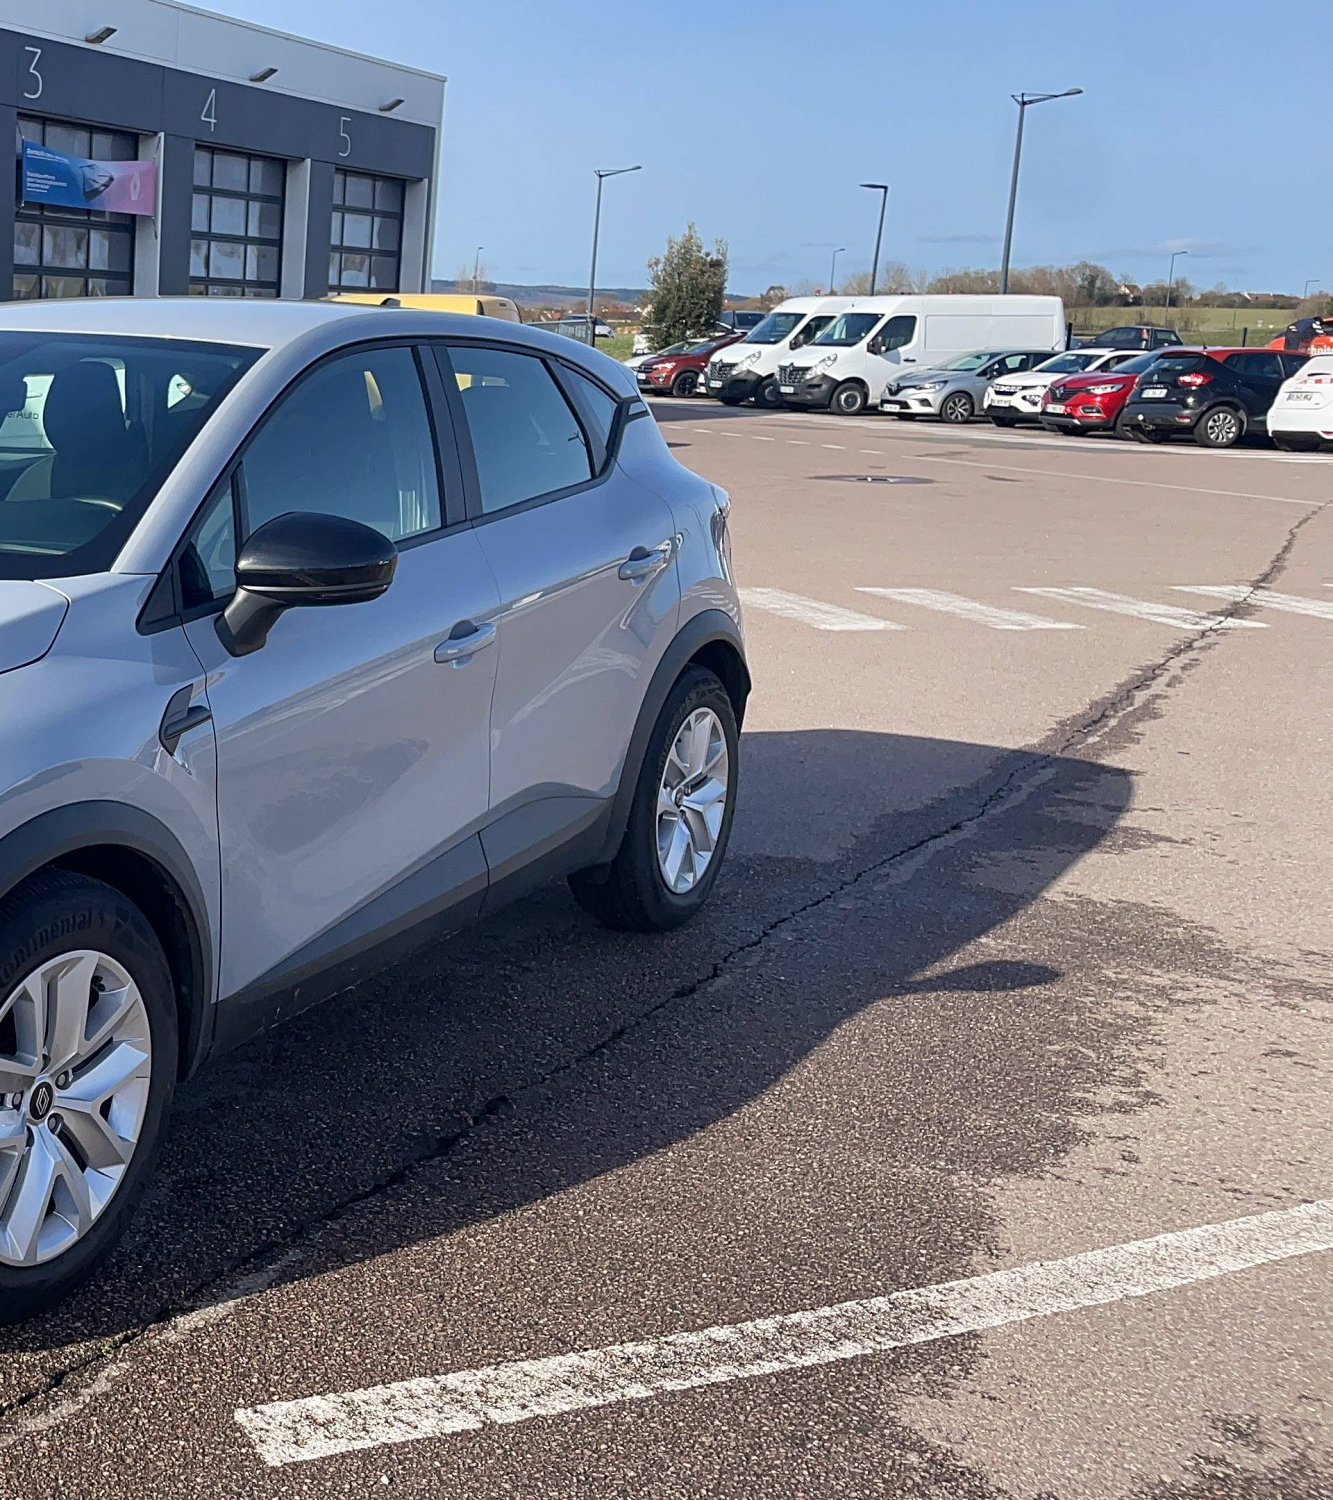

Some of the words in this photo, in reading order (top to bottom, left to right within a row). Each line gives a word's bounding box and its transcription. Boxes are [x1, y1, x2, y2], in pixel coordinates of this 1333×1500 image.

[23, 46, 43, 99] 3
[200, 88, 218, 132] 4
[338, 116, 352, 157] 5
